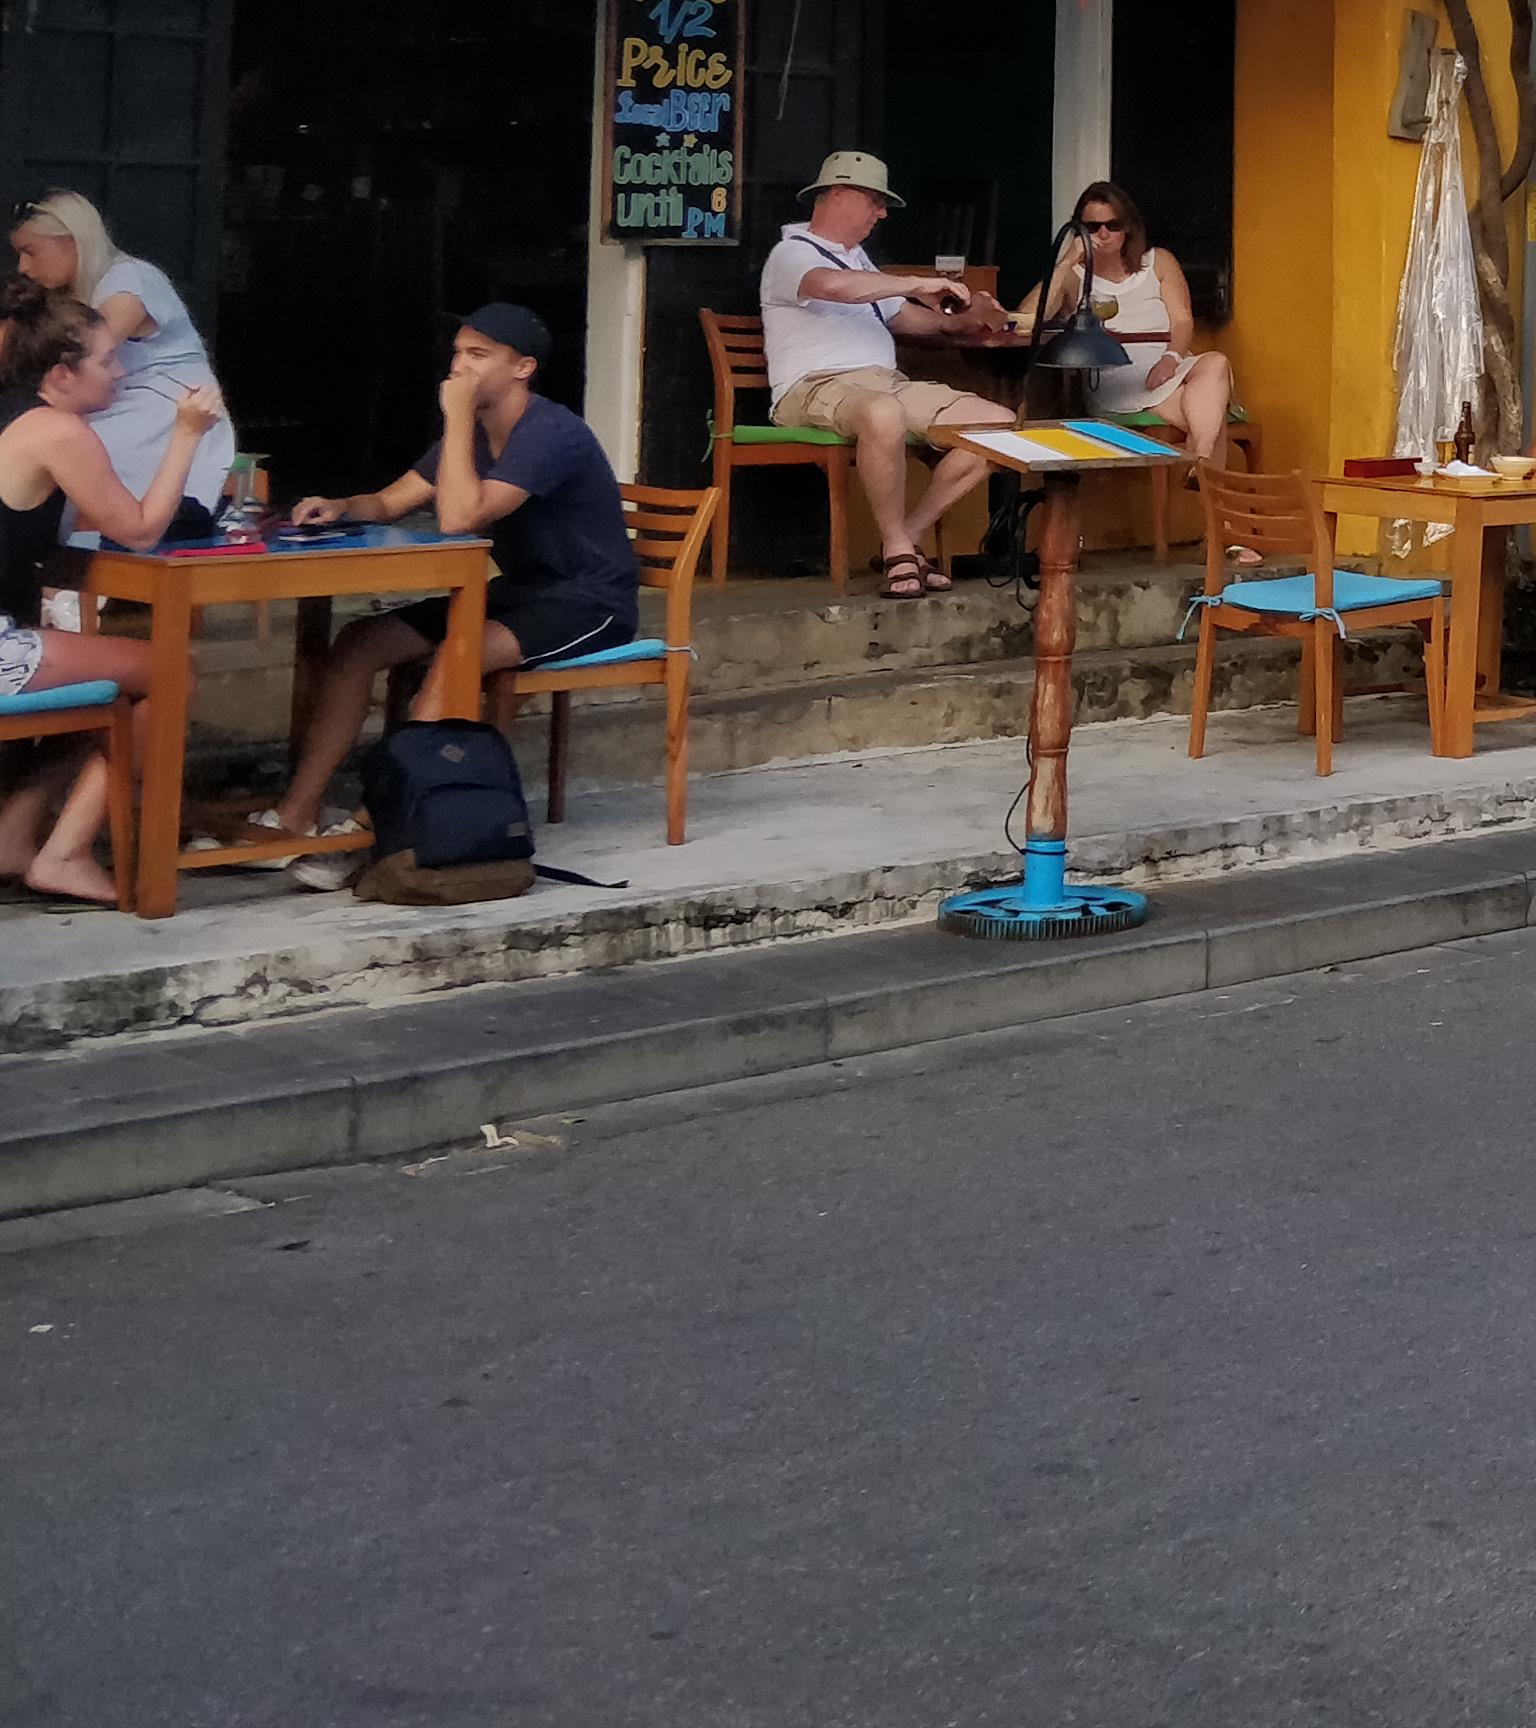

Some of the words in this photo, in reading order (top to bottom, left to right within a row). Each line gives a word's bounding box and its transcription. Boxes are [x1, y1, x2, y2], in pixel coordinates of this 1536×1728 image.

[649, 0, 717, 44] 1/2
[617, 37, 733, 89] Price
[617, 186, 684, 227] until
[711, 187, 727, 212] 6
[682, 207, 726, 238] PM
